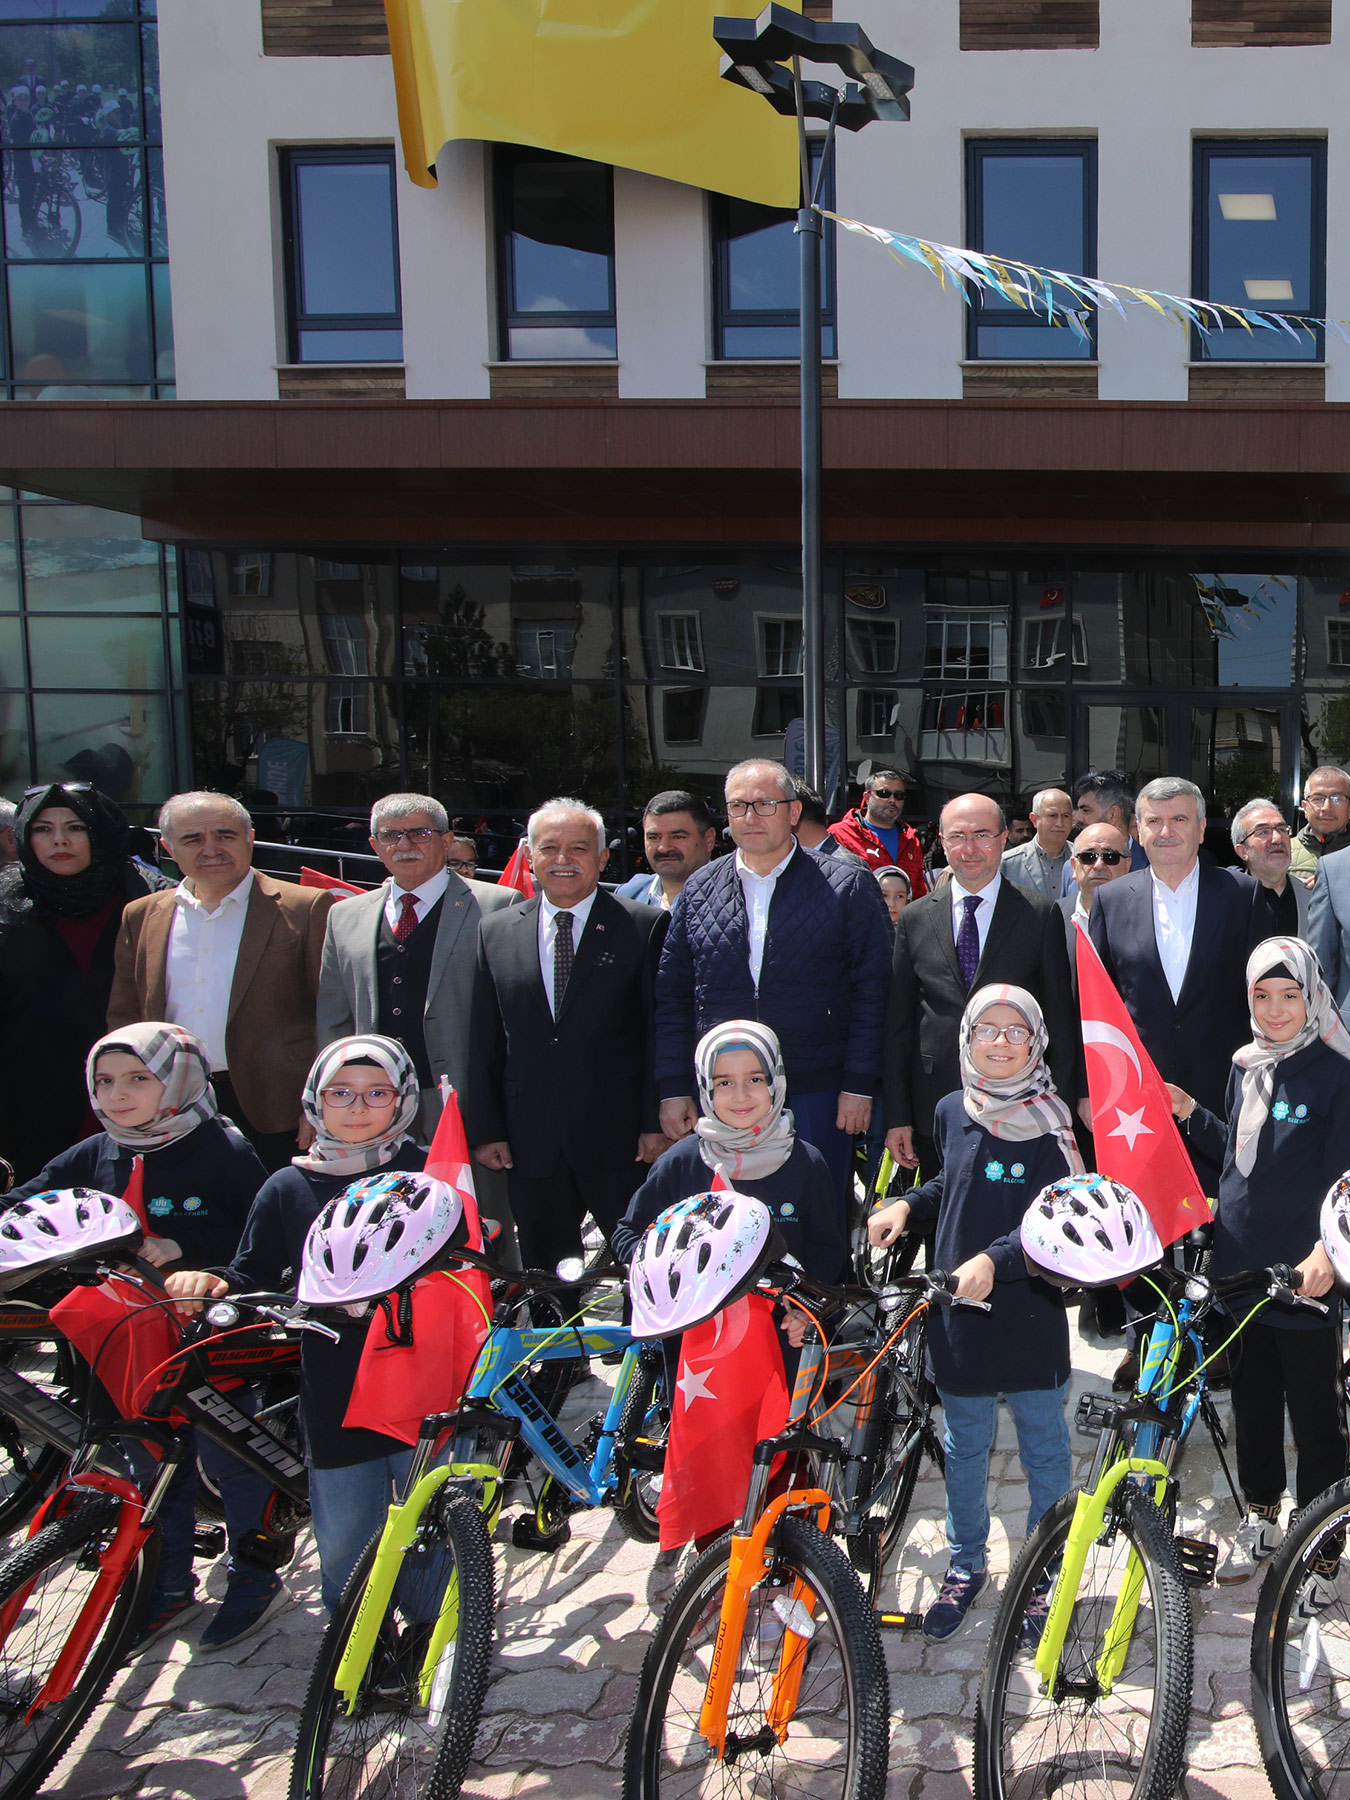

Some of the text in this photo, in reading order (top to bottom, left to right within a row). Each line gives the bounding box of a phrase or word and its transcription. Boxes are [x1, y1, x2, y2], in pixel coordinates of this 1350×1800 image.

[211, 1349, 275, 1363] MAGNUM
[345, 1582, 374, 1663] MAGNUM
[1043, 1567, 1067, 1643] MAGNUM
[707, 1621, 727, 1705] MAGNUM
